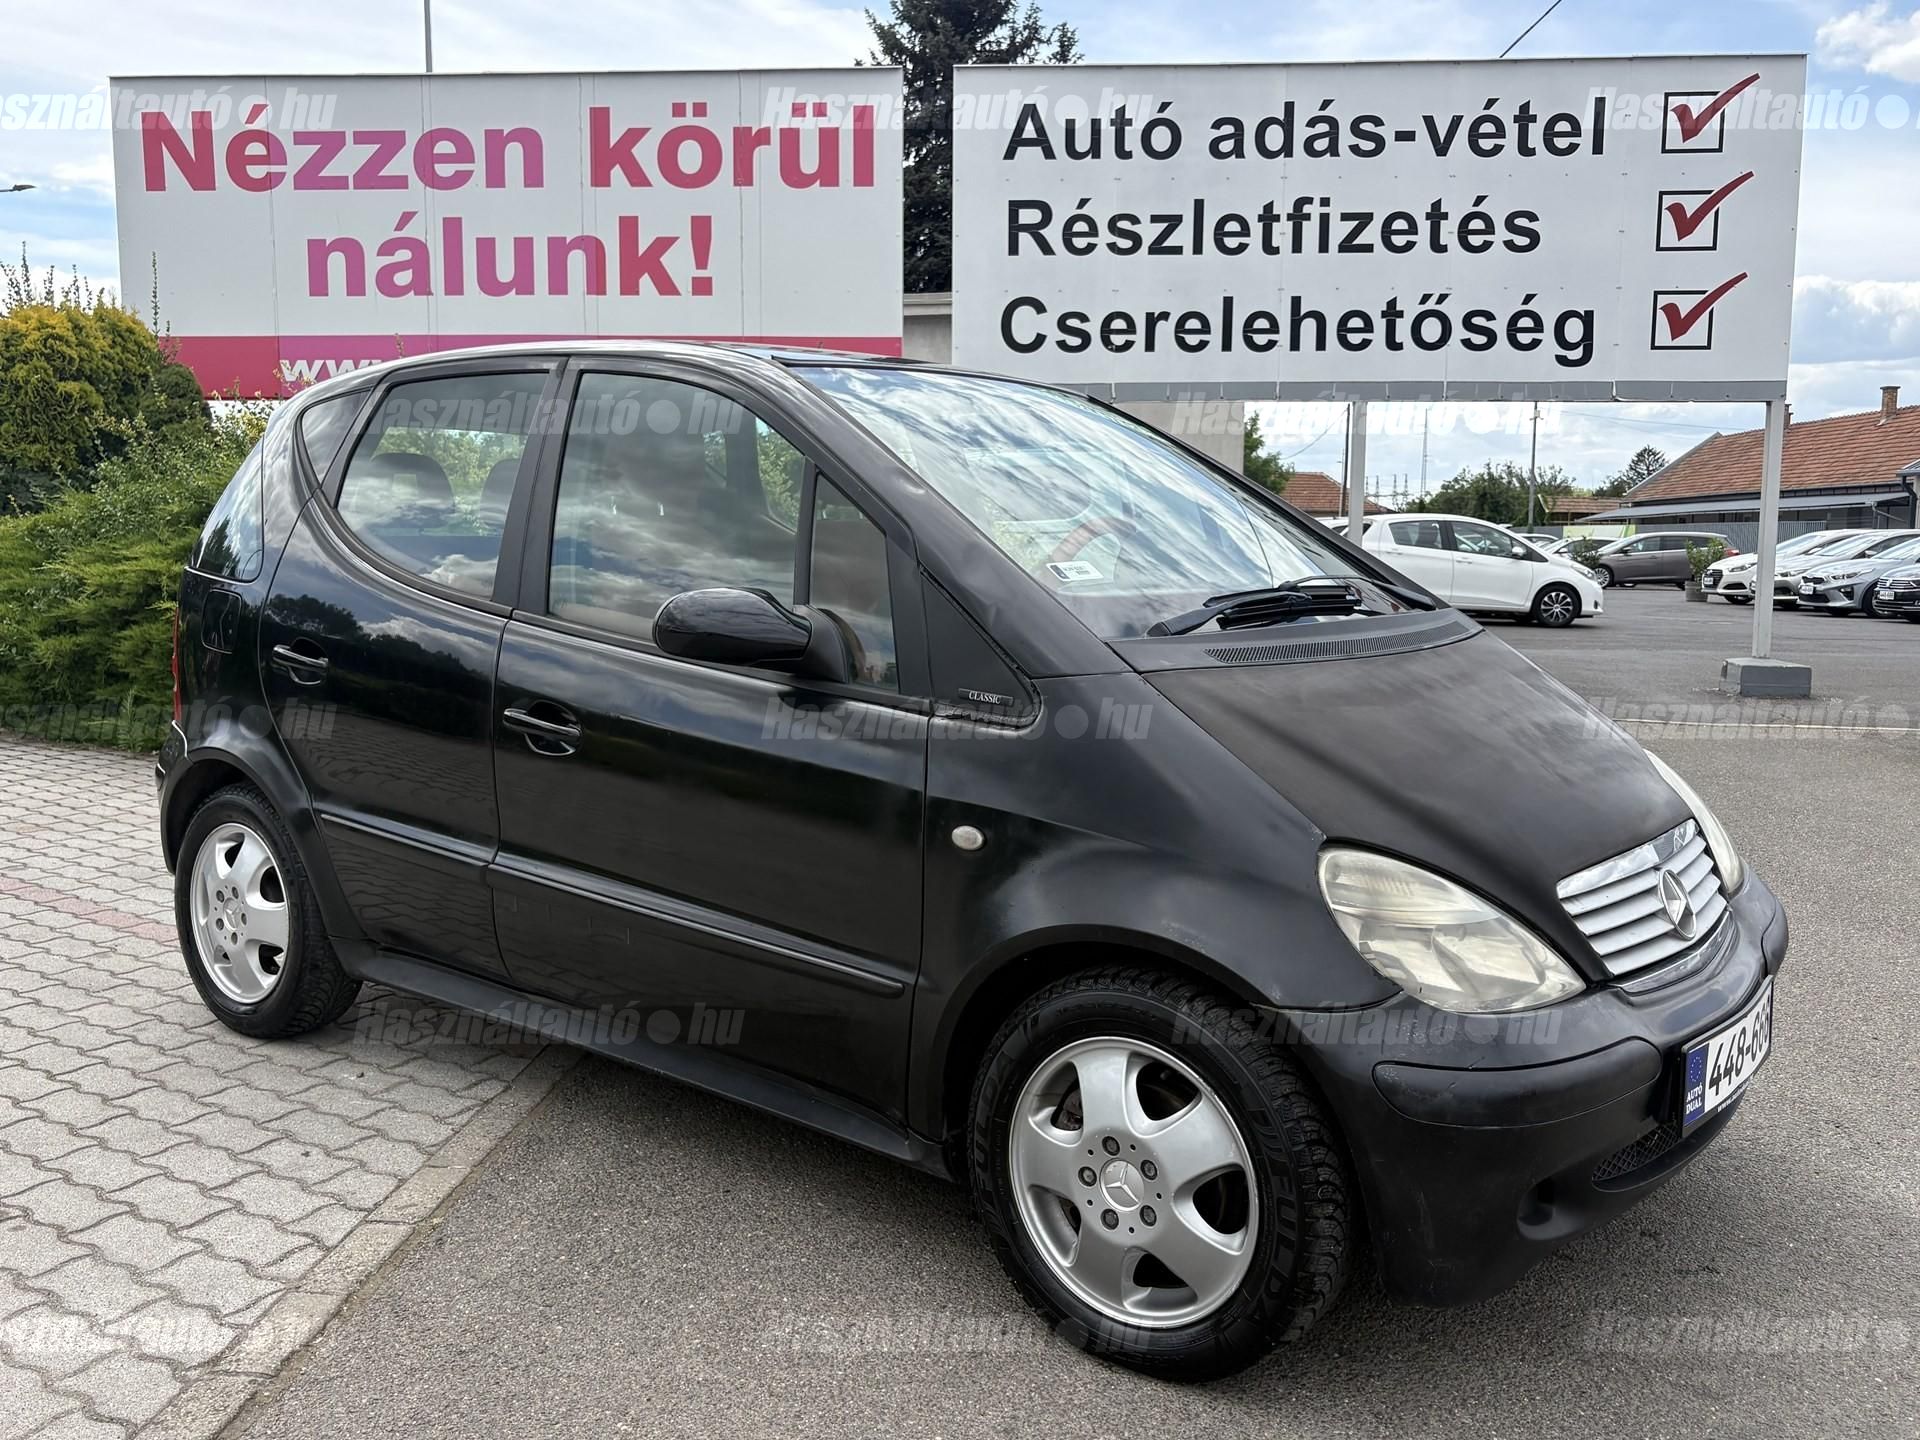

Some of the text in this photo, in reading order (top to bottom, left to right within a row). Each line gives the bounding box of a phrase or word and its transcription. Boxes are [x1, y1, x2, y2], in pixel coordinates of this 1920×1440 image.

[142, 103, 874, 192] Nézzen körül
[1003, 97, 1606, 161] Autó adás-vétel
[308, 211, 712, 297] nálunk!
[1008, 196, 1541, 256] Részletfizetés
[1000, 293, 1595, 368] Cserelehetőség
[968, 690, 1001, 705] CLASSIC
[1686, 1082, 1703, 1103] AUTÓ
[1686, 1096, 1703, 1115] DUAL
